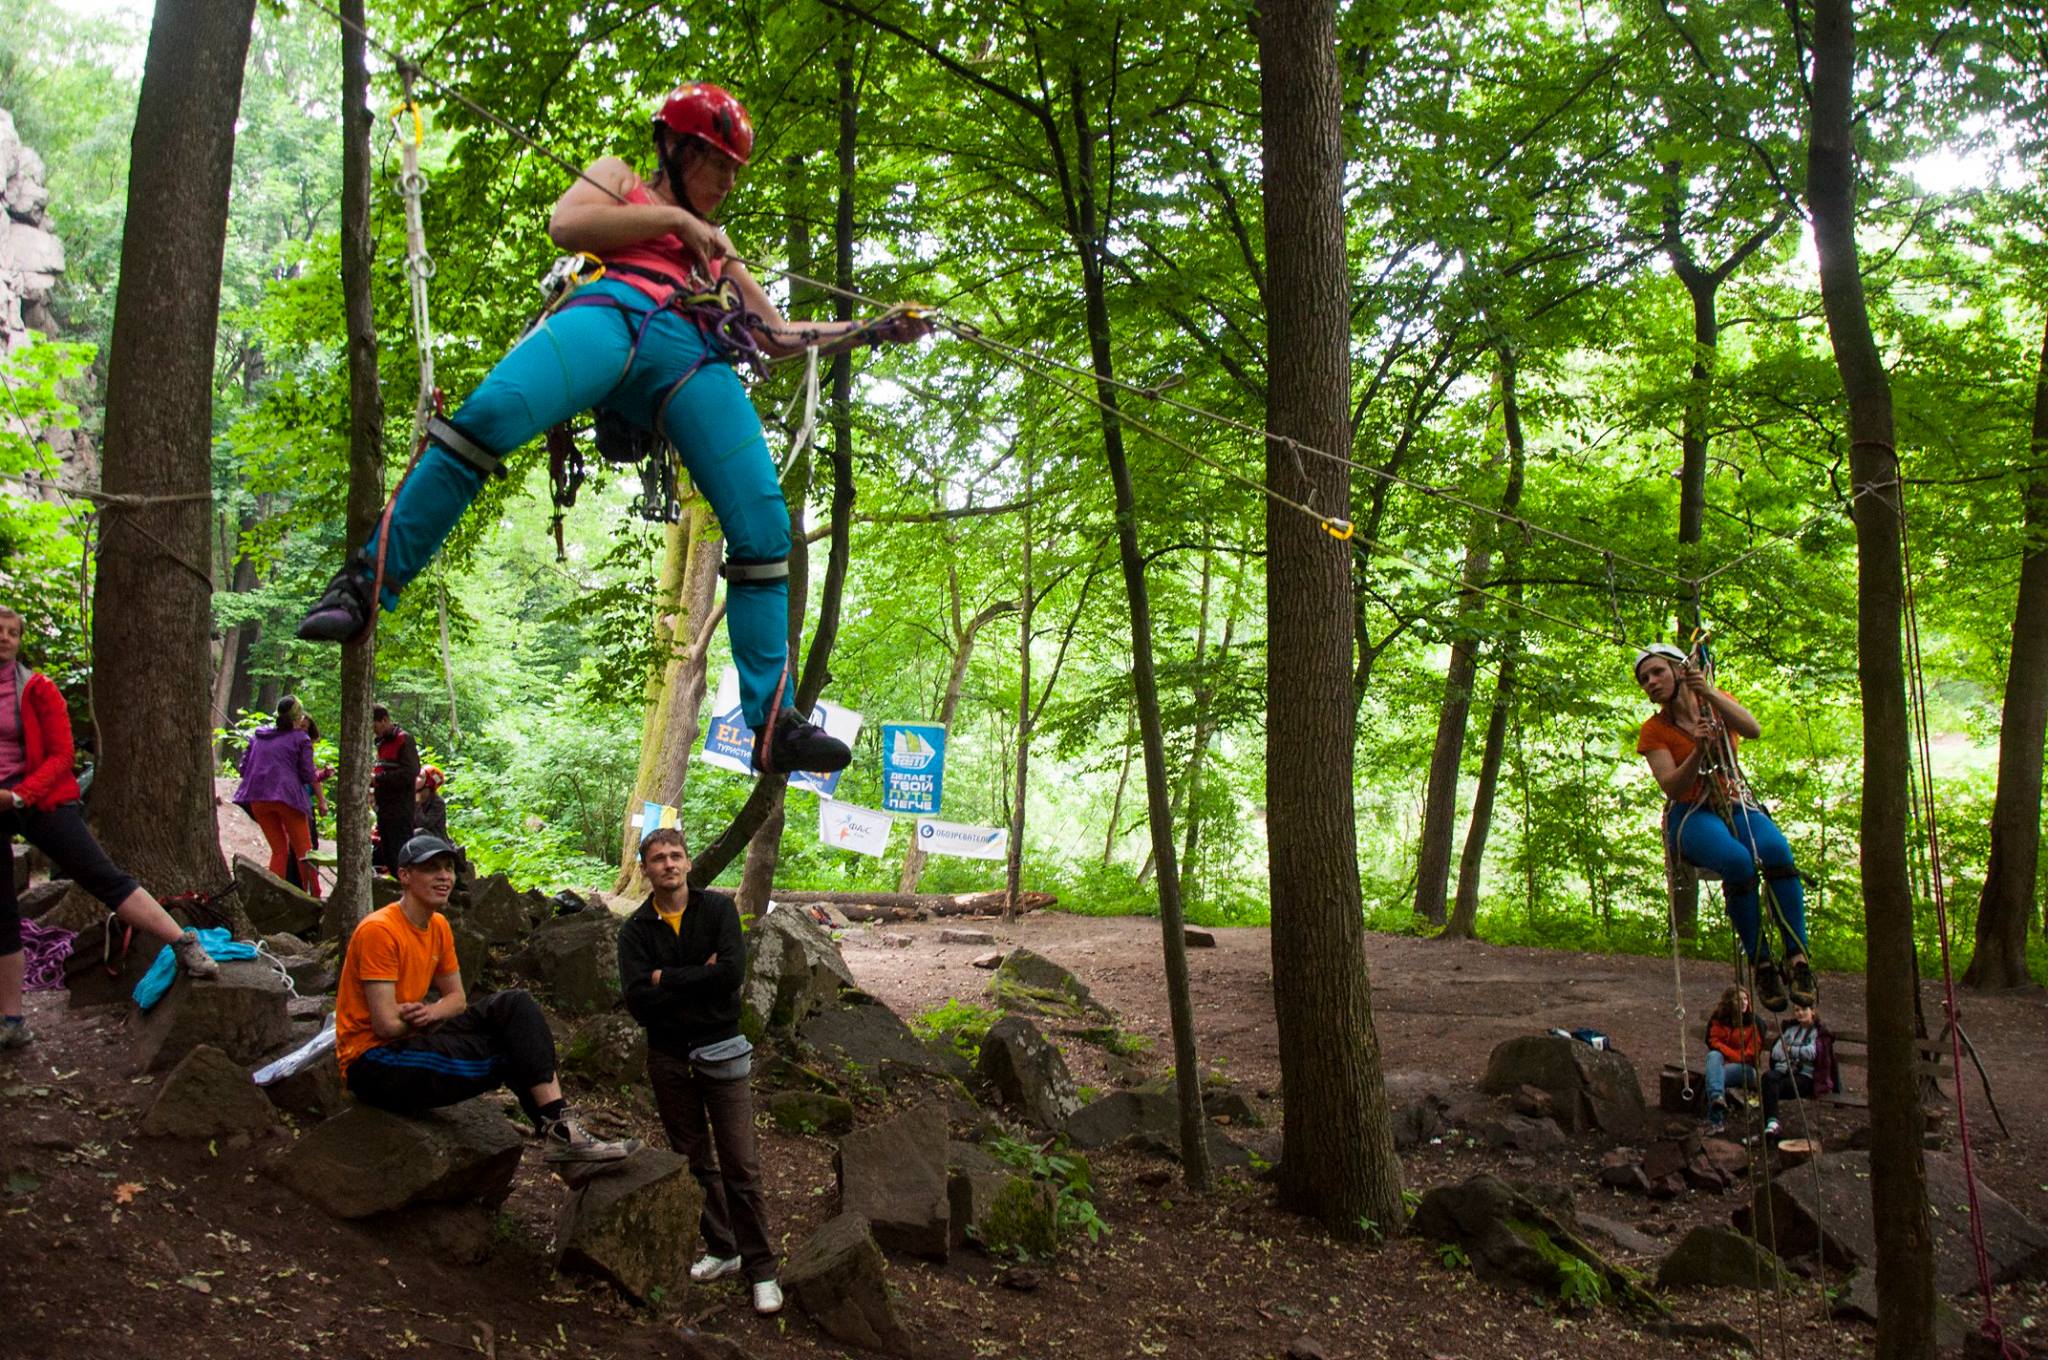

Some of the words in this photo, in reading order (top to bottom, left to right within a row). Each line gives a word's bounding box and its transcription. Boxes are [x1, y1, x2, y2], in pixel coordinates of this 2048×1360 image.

[716, 723, 755, 748] EL-
[717, 742, 752, 758] ТУРИСТИ
[890, 772, 934, 783] ДЕЛАЕТ
[889, 789, 933, 801] ПУТЬ
[889, 799, 933, 810] ЛЕГЧЕ
